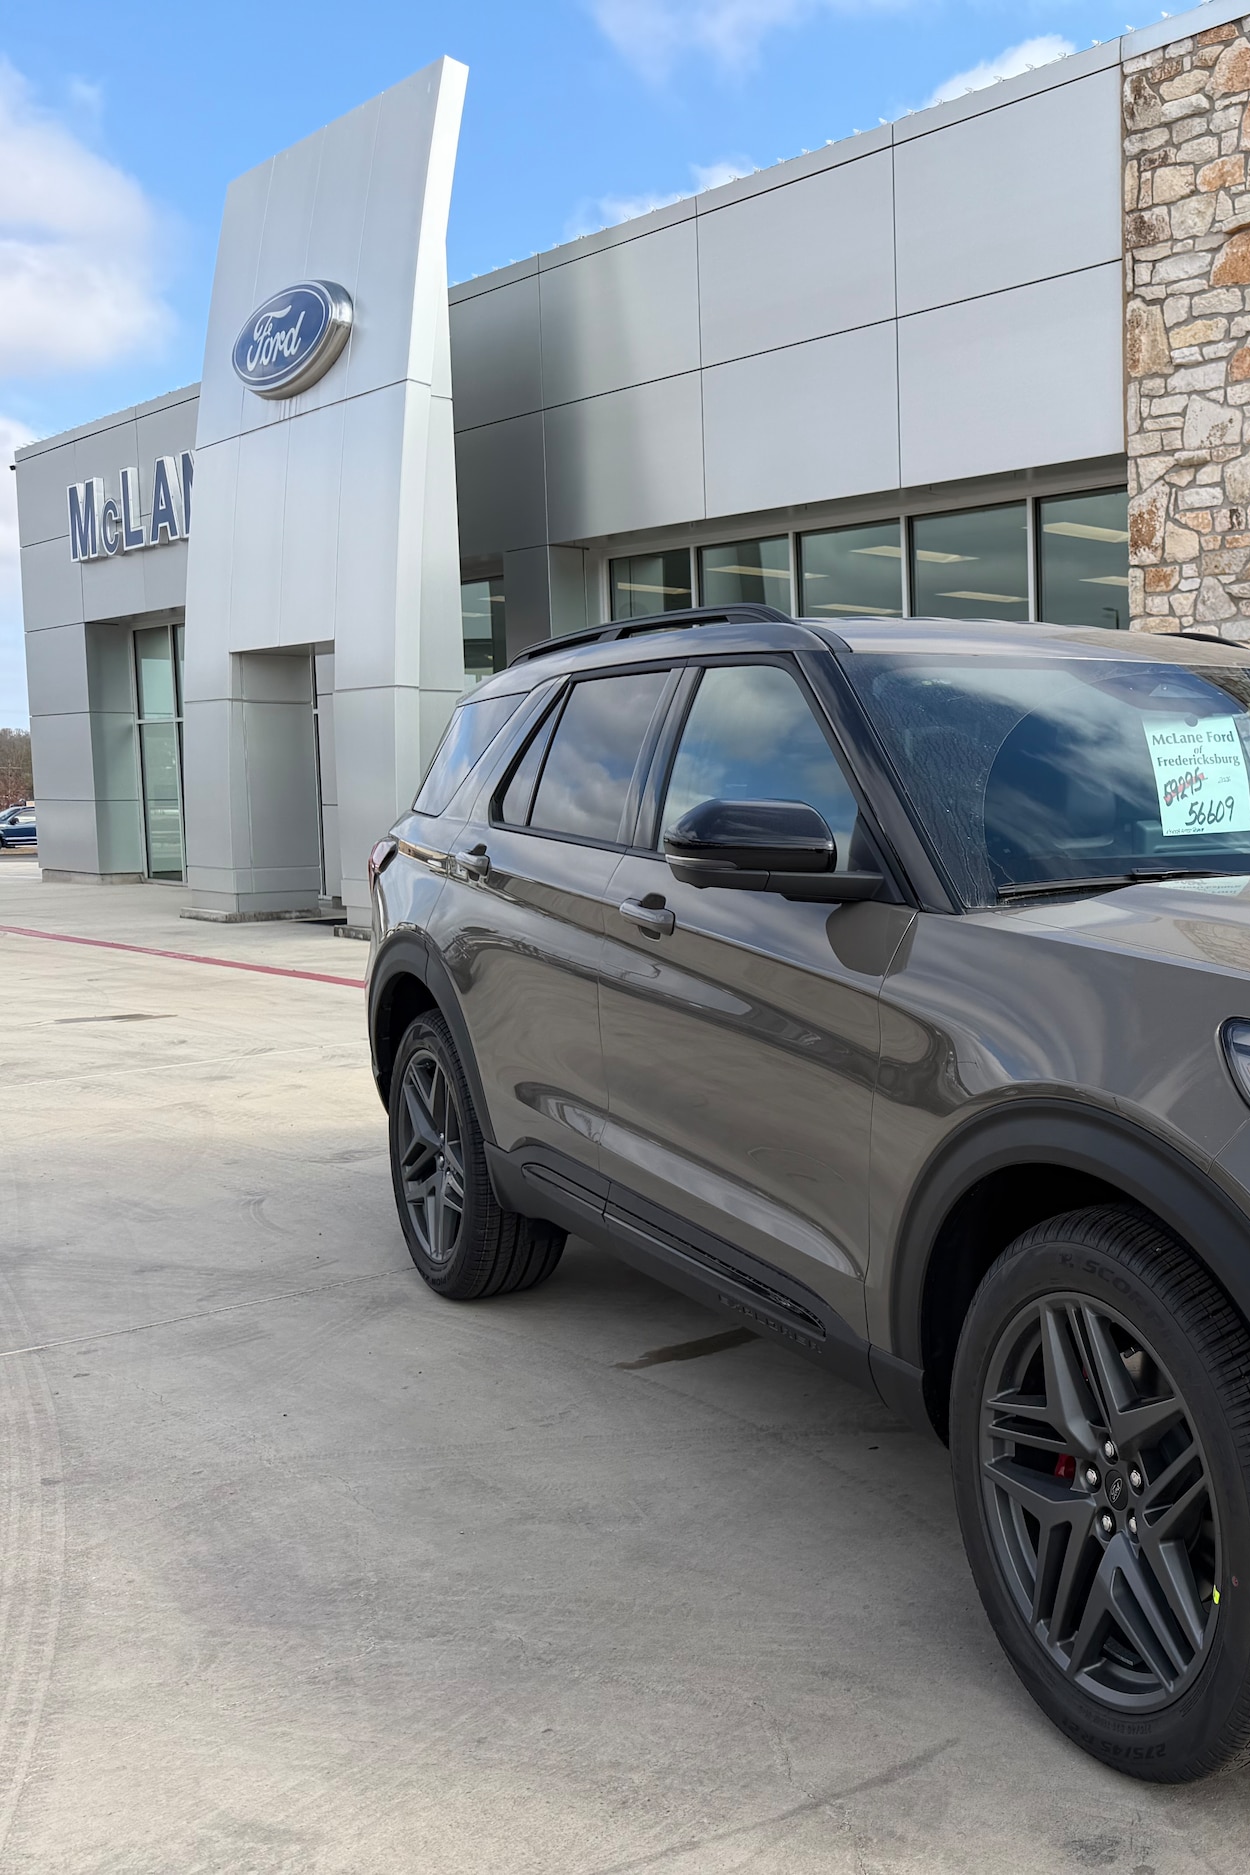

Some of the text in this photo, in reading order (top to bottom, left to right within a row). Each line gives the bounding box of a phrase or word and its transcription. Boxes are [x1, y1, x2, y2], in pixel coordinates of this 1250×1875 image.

[246, 303, 306, 372] Ford
[1152, 730, 1235, 746] McLane Ford
[1193, 745, 1203, 754] of
[1157, 754, 1241, 767] Fredericksburg
[1185, 795, 1235, 826] 56609
